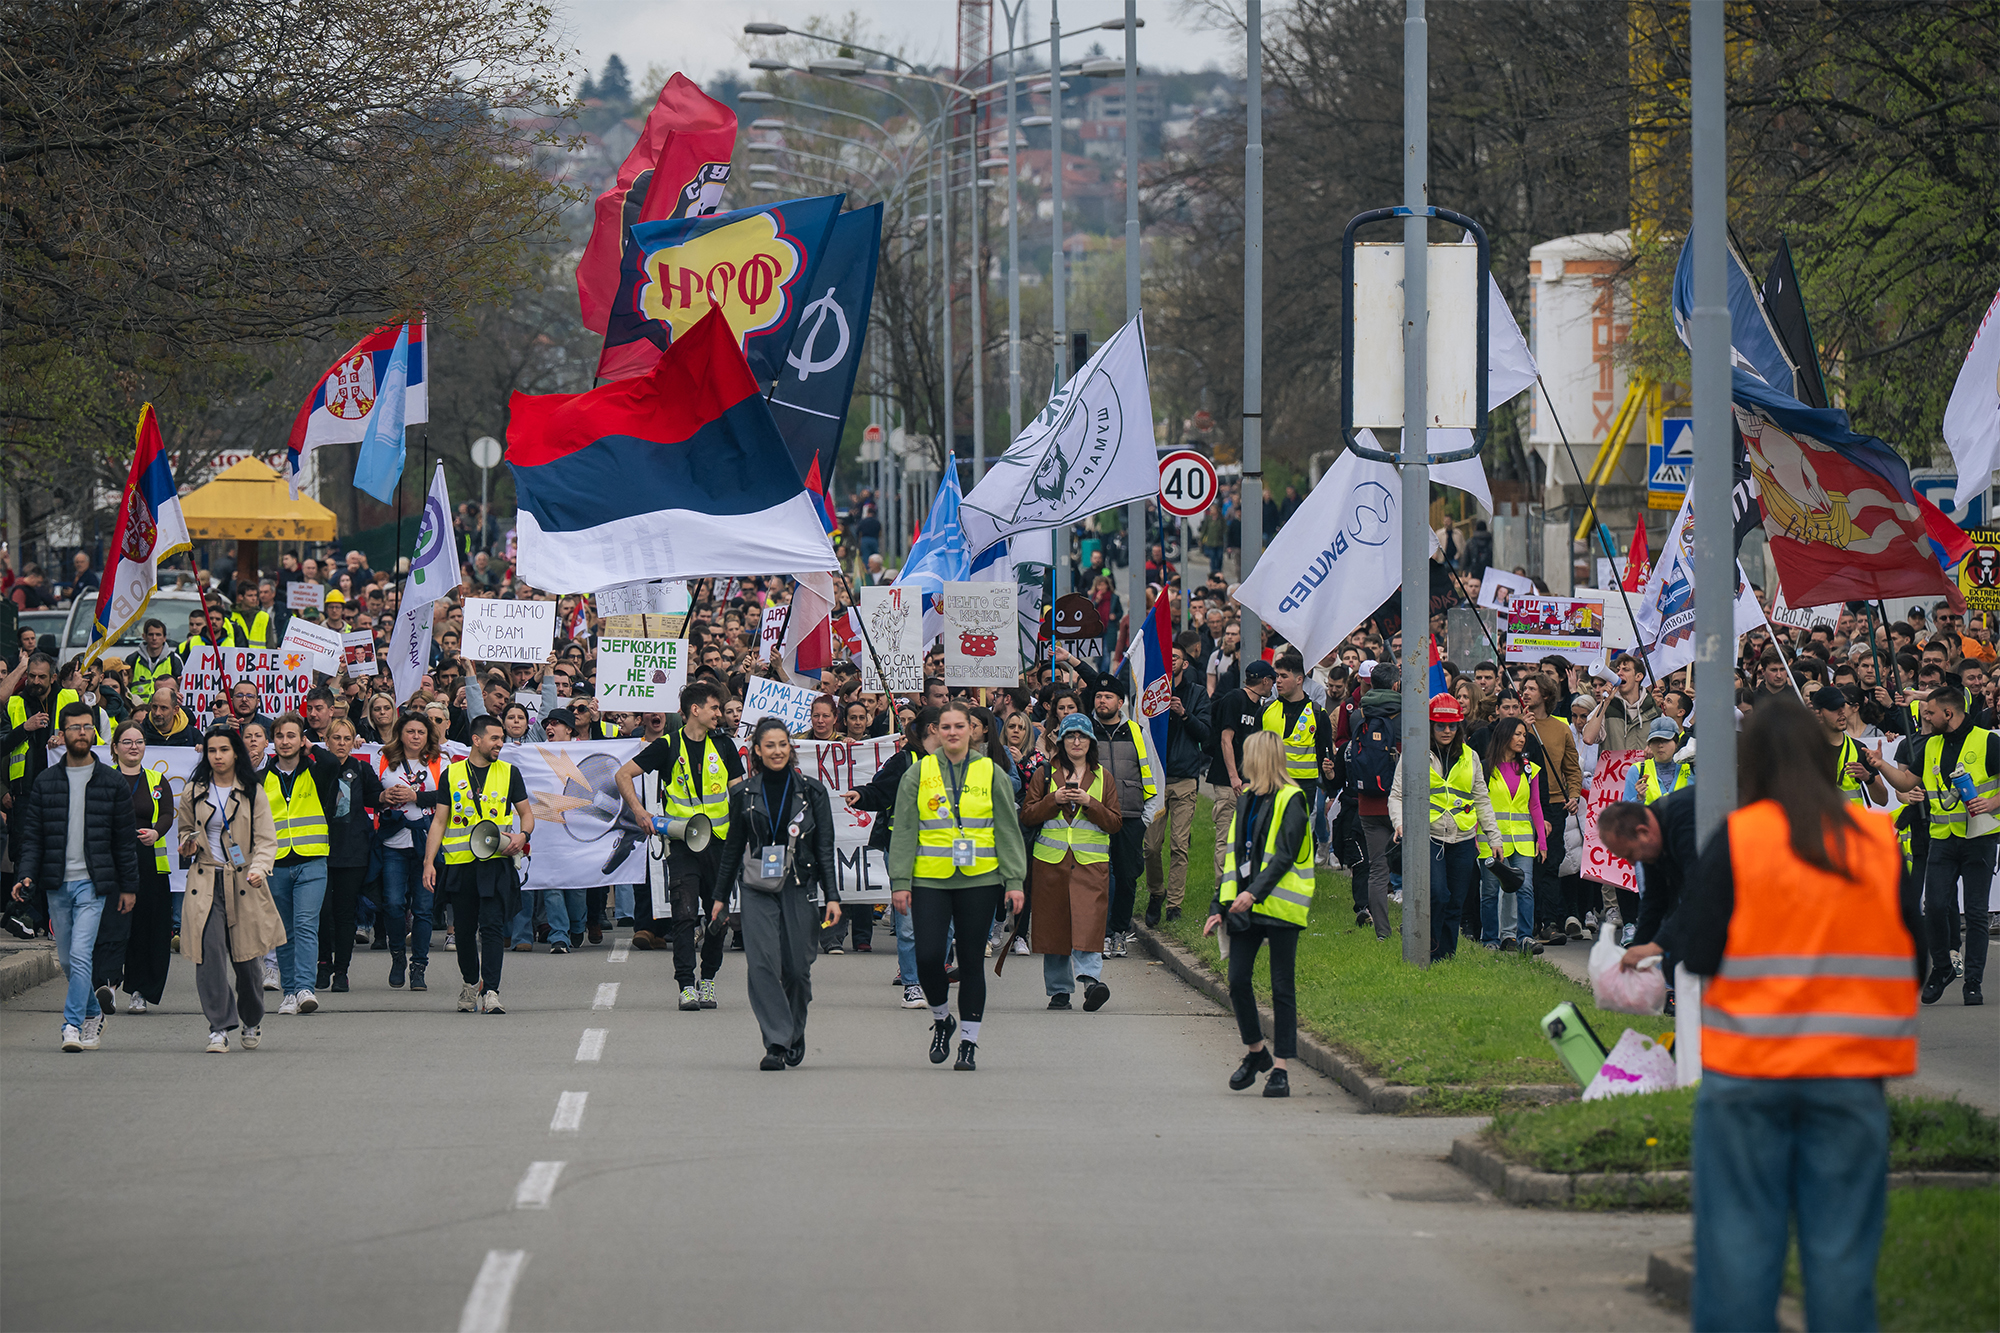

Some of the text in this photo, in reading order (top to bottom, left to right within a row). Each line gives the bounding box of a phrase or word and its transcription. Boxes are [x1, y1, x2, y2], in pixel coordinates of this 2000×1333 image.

[1164, 467, 1204, 500] 40
[1964, 530, 2000, 543] AUTI
[632, 588, 642, 598] НЕ
[947, 596, 989, 609] НЕШТО
[992, 596, 1010, 609] СЕ
[480, 603, 545, 619] НЕ ДАМО
[959, 610, 1002, 622] КРЧКА
[1774, 605, 1811, 628] СВОЈУ
[495, 625, 524, 639] ВАМ
[478, 644, 542, 660] СВРАТИШТЕ
[601, 639, 677, 655] ЈЕРКОВИЋ
[1041, 639, 1101, 660] МТКА
[201, 652, 280, 672] МИ ОВДЕ
[634, 654, 677, 669] БРАЋЕ
[893, 654, 915, 666] САМ
[974, 657, 983, 666] У
[627, 669, 646, 682] НЕ
[945, 665, 1017, 679] ЈЕРКОВИЋУ
[184, 673, 309, 694] НИСМО НИСМО
[603, 683, 655, 698] У ГАЋЕ
[864, 679, 923, 691] НЕШО МОЈЕ
[759, 680, 817, 706] ИМА ДЕ
[749, 693, 768, 710] КО
[768, 700, 788, 715] ДА
[920, 775, 943, 791] PRESS
